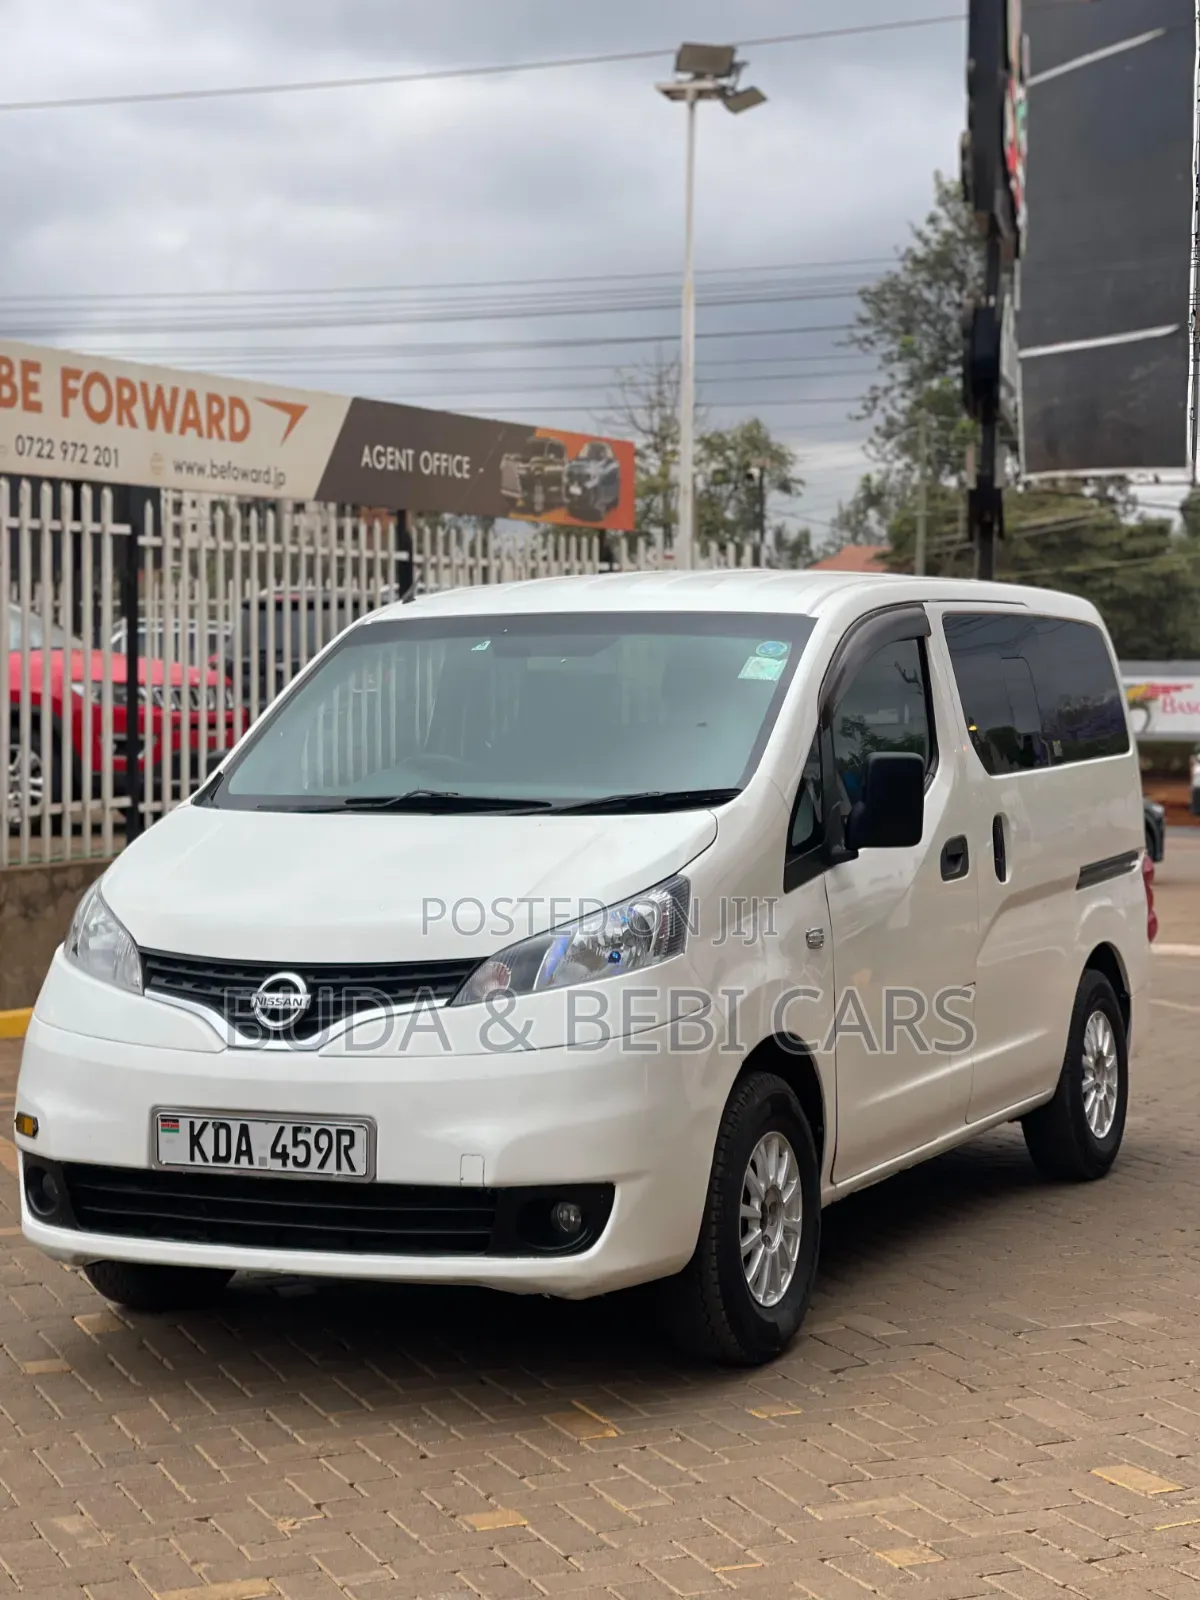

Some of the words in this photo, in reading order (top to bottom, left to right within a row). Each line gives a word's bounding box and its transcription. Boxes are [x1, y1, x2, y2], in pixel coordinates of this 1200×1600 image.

[0, 356, 43, 414] BE
[60, 366, 251, 443] FORWARD
[15, 434, 55, 460] 0722
[60, 440, 88, 463] 972
[93, 445, 119, 468] 201
[361, 445, 414, 473] AGENT
[419, 450, 471, 479] OFFICE
[255, 997, 303, 1007] NISSAN
[189, 1120, 254, 1165] KDA
[270, 1125, 357, 1172] 459R
